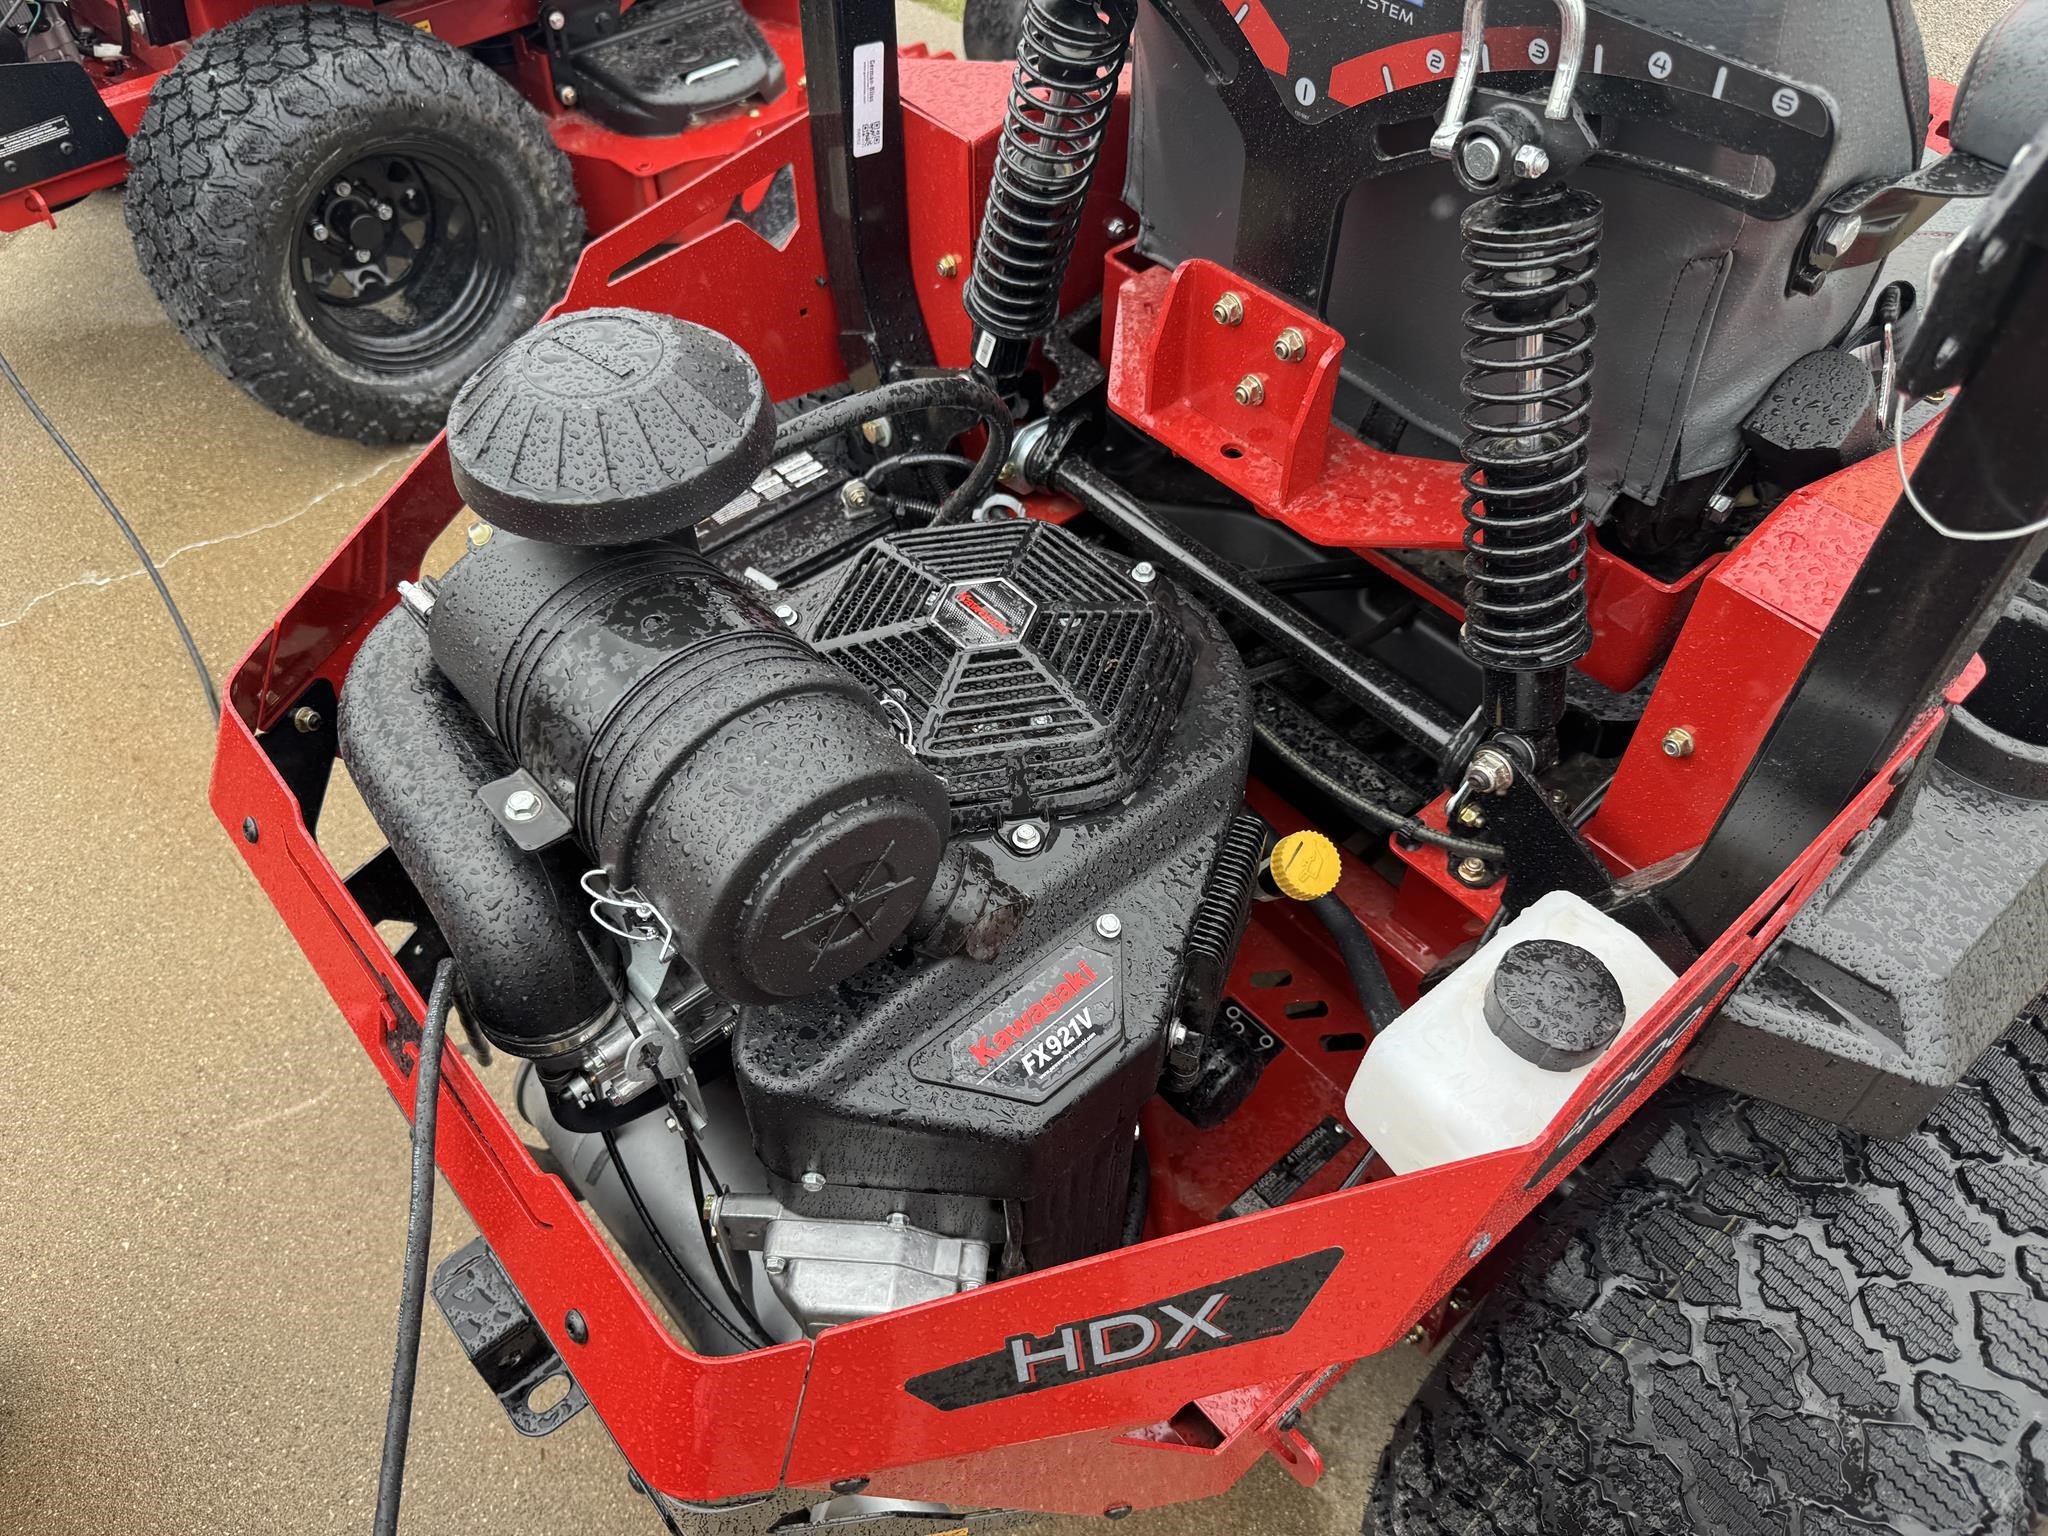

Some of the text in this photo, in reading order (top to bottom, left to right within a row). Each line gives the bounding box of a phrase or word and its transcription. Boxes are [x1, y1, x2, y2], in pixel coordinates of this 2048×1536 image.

[968, 959, 1098, 1067] Kawasaki
[1020, 1006, 1093, 1077] FX921V
[1558, 1006, 1703, 1148] 4000
[1011, 1293, 1233, 1384] HDX
